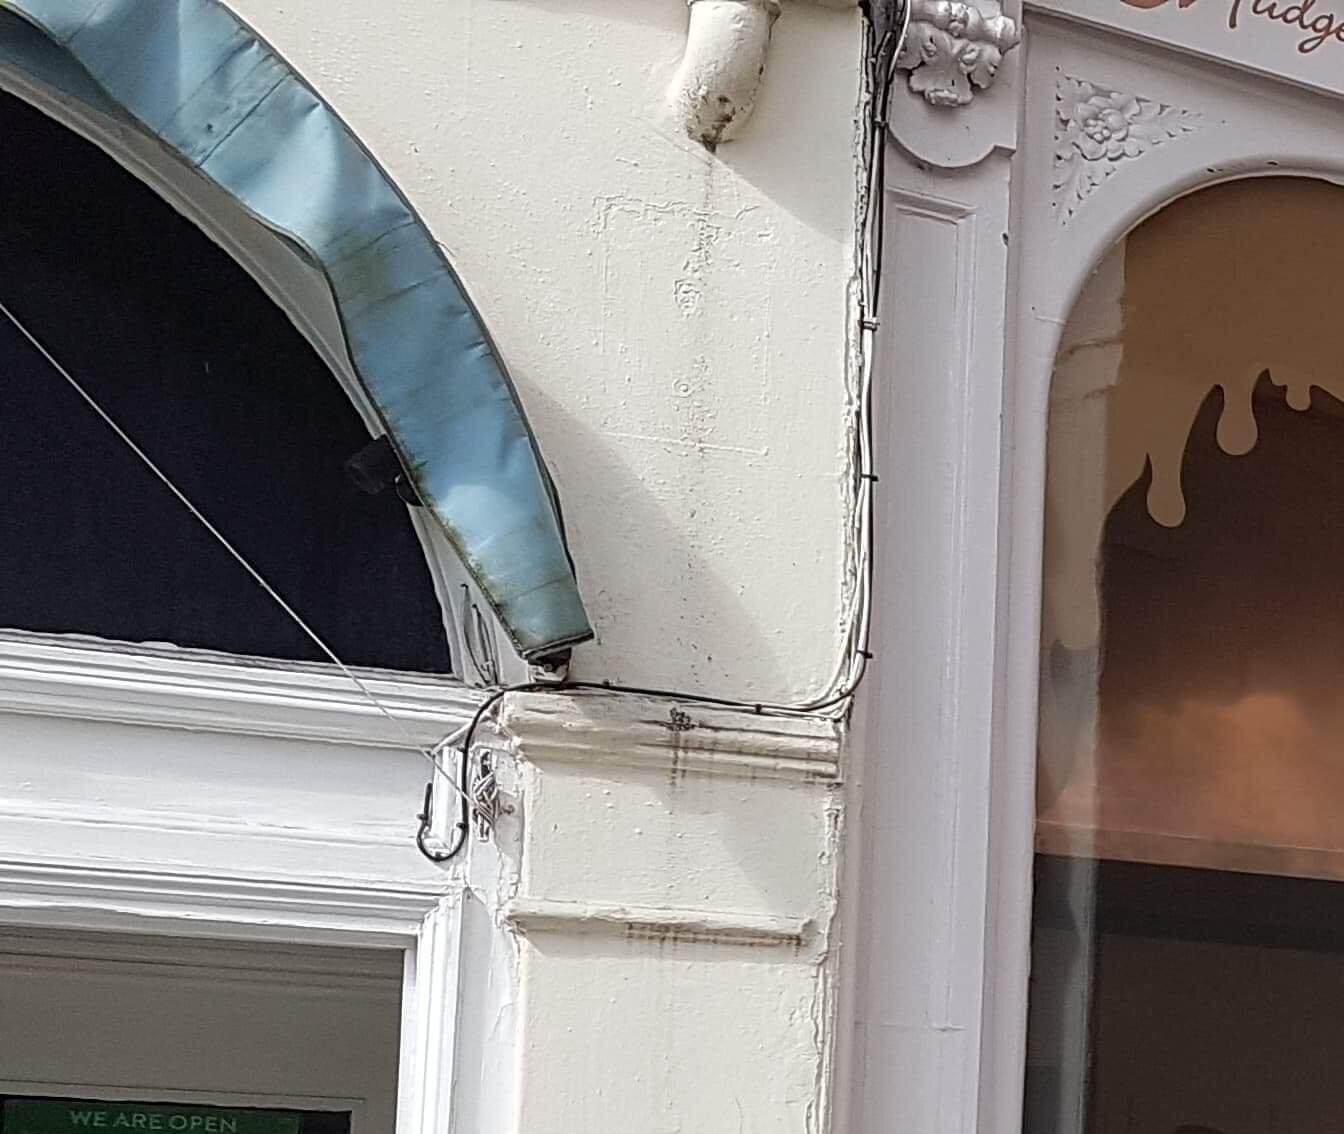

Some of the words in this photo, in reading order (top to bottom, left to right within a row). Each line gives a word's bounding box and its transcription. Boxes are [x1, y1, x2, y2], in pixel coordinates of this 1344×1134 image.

[70, 1110, 107, 1127] WE
[112, 1112, 163, 1130] ARE
[169, 1115, 237, 1133] OPEN
